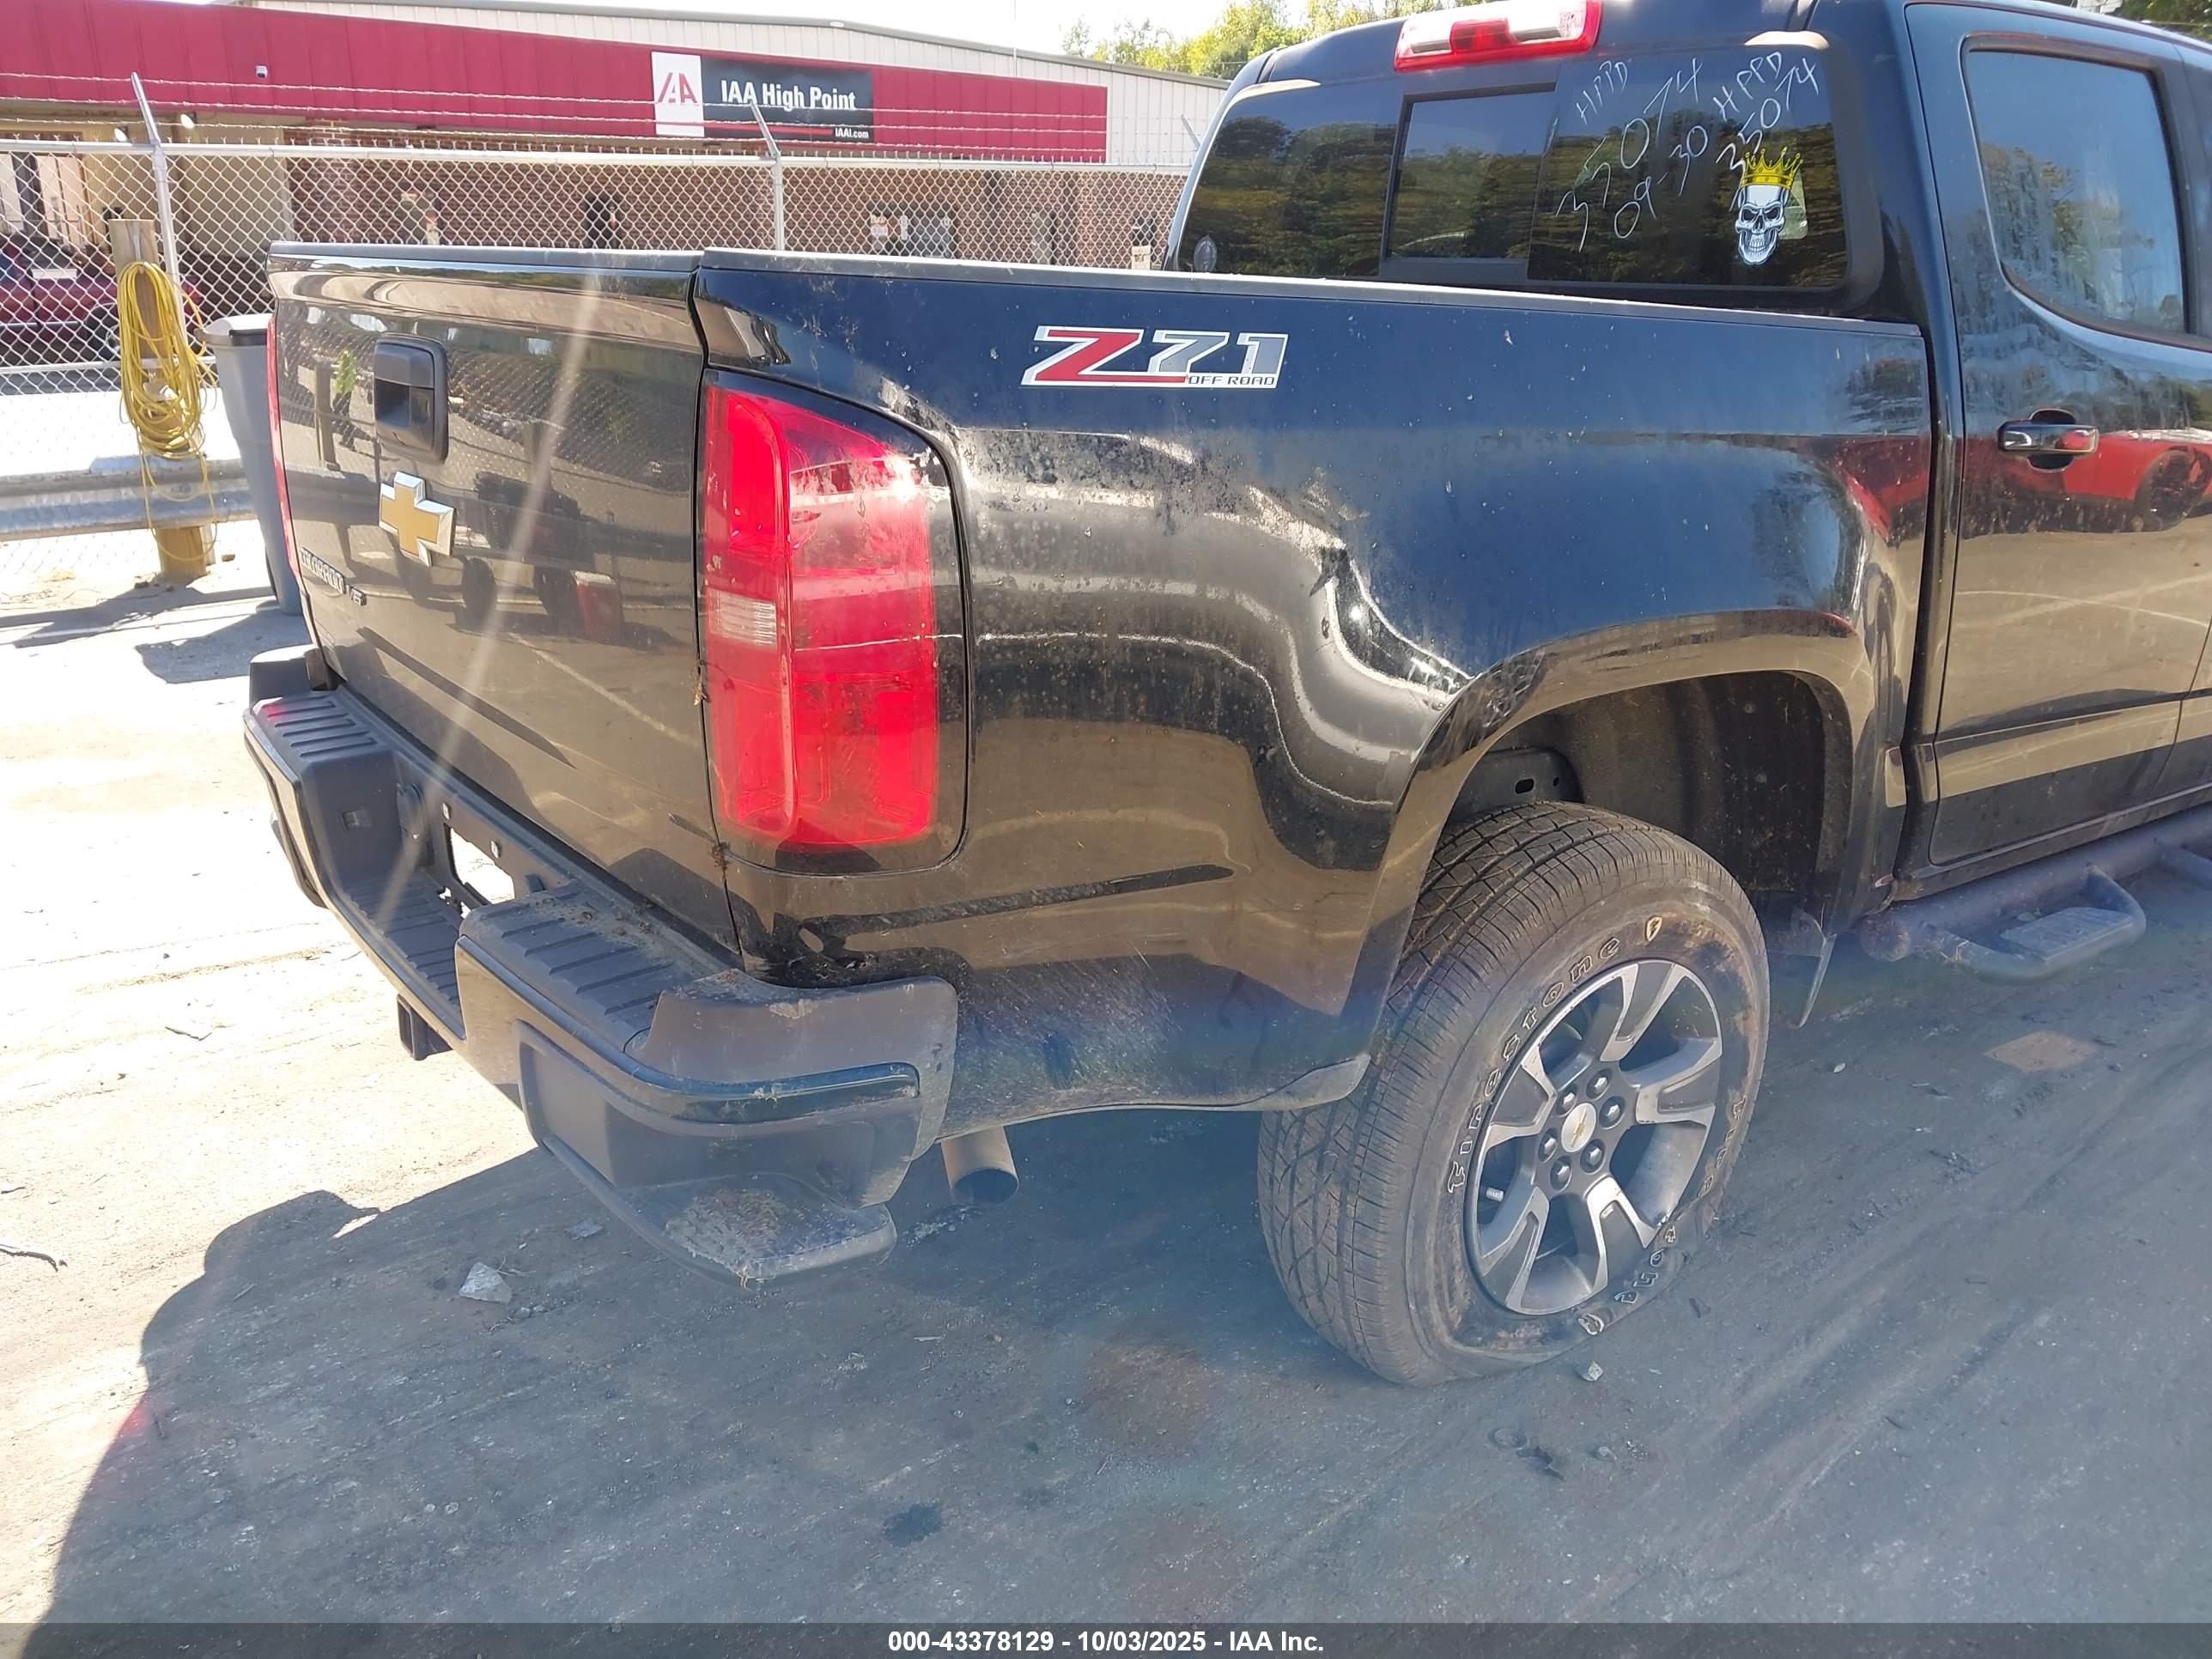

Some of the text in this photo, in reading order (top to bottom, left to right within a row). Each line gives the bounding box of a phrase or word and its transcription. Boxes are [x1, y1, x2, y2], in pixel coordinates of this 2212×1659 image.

[721, 80, 858, 112] IAA High Point
[1712, 52, 1782, 122] HPPD
[835, 128, 869, 139] IAAI.com
[1021, 325, 1288, 387] Z71
[1188, 375, 1275, 386] OFF ROAD
[1448, 938, 1620, 1194] Firestone
